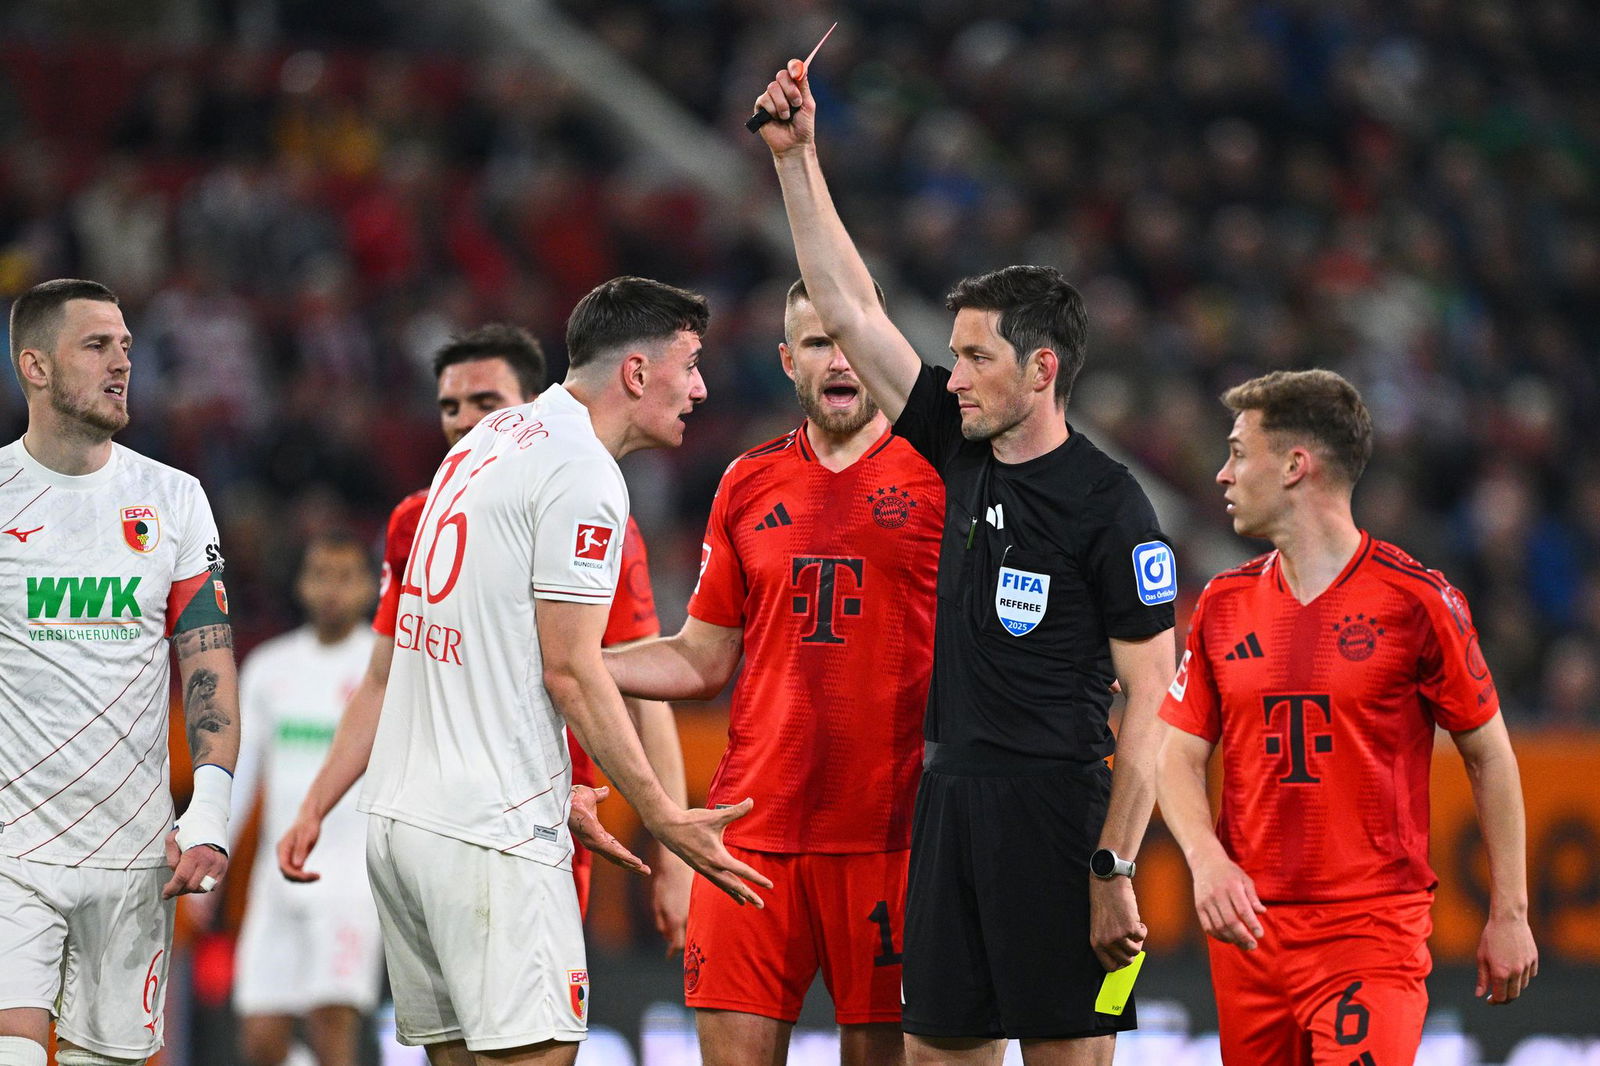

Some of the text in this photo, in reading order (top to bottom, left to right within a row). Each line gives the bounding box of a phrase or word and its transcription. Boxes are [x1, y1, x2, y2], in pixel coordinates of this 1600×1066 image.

[124, 508, 154, 519] FCA
[401, 449, 498, 605] 16
[1002, 572, 1043, 594] FIFA
[27, 576, 142, 618] WWK
[1156, 589, 1175, 599] Örtliche
[999, 597, 1042, 613] REFEREE
[1007, 620, 1028, 631] 2025
[28, 627, 142, 642] VERSICHERUNGEN
[1334, 980, 1371, 1046] 6
